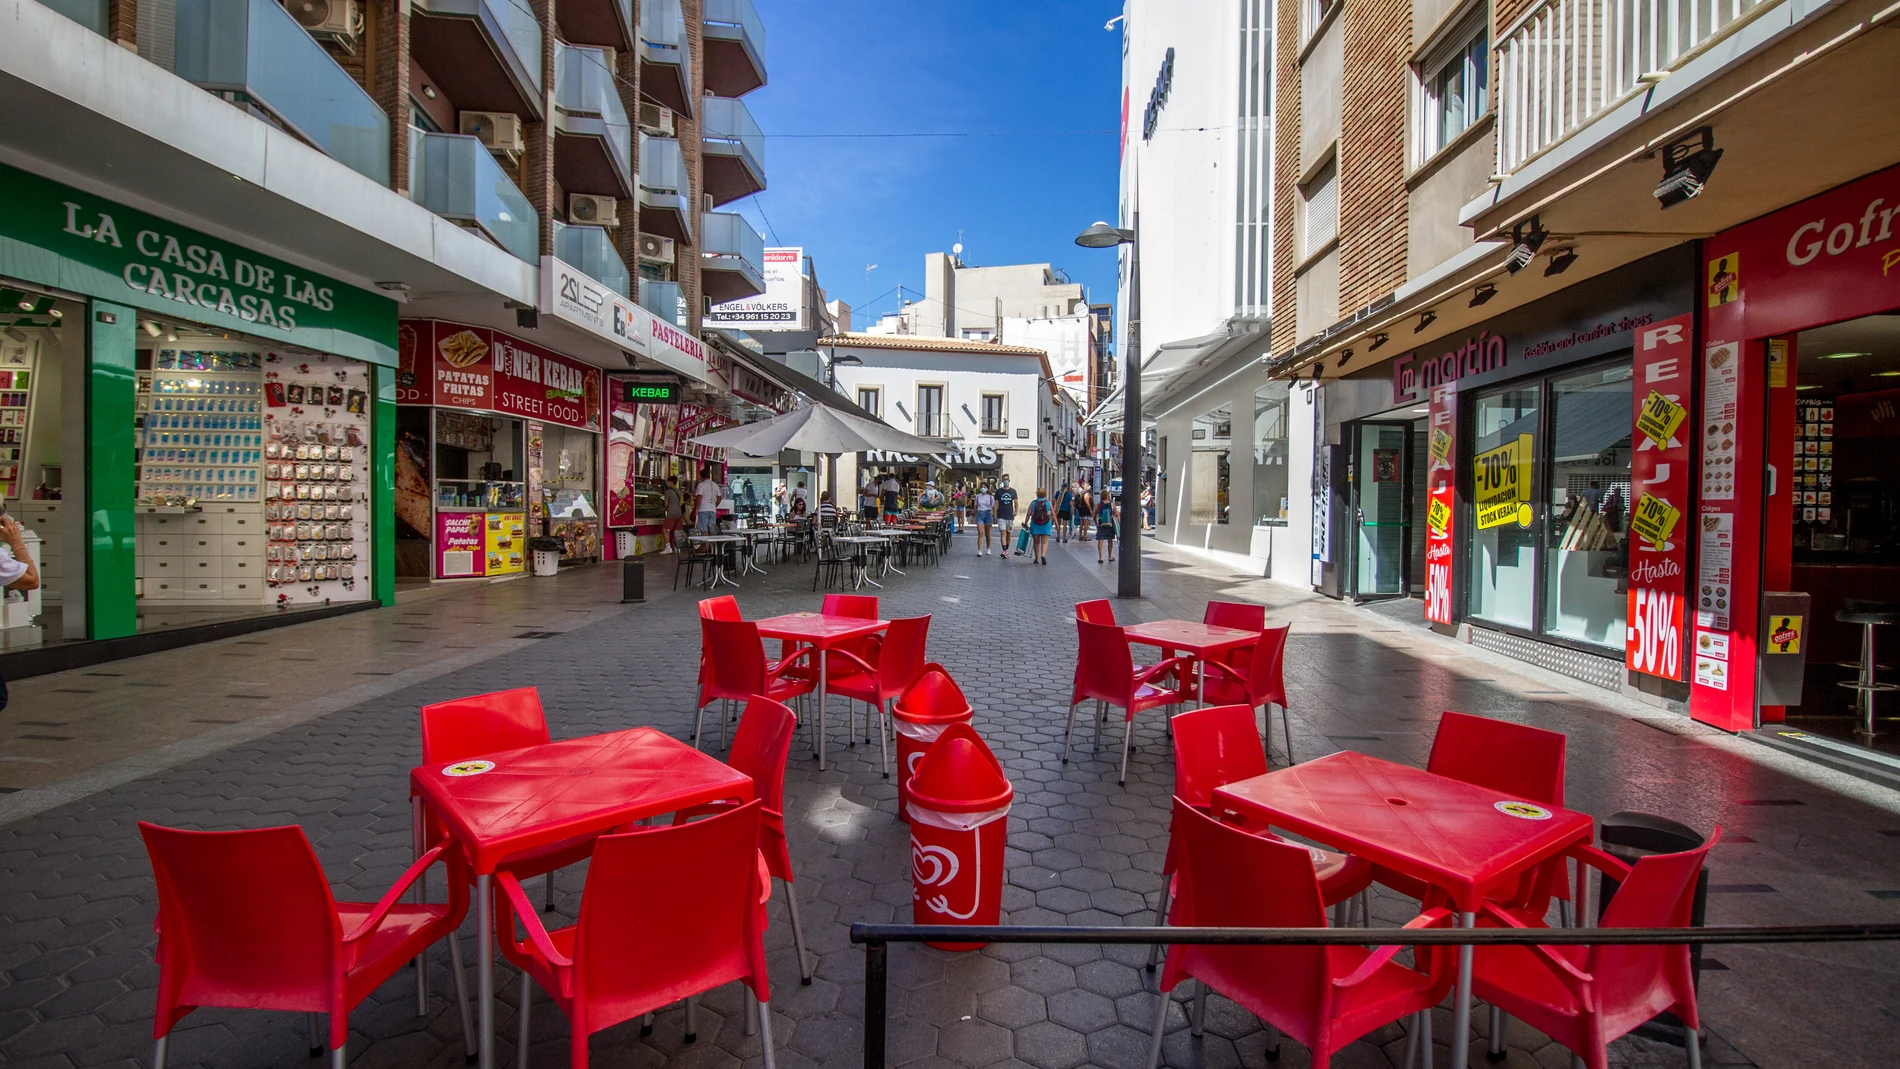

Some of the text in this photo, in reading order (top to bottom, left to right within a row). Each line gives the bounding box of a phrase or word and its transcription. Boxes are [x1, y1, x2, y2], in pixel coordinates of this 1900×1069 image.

[1786, 198, 1900, 266] Gofr
[63, 201, 334, 312] LA CASA DE LAS
[123, 263, 296, 331] CARCASAS
[560, 300, 604, 327] APARTMENTS
[651, 319, 704, 362] PASTELERIA
[1524, 313, 1653, 359] fashion and comfort shoes
[1421, 330, 1507, 389] martín
[437, 369, 490, 386] PATATAS
[443, 382, 485, 397] FRITAS
[632, 387, 670, 398] KEBAB
[451, 396, 476, 406] CHIPS
[502, 391, 544, 415] STREET
[547, 403, 579, 422] FOOD
[1648, 394, 1672, 426] -70%
[1636, 324, 1684, 552] REAJ
[1430, 387, 1453, 540] REAJS
[1476, 448, 1517, 491] -70%
[445, 519, 471, 527] SALCHI
[1480, 502, 1518, 526] STOCK VERANO
[1640, 495, 1667, 527] -70%
[445, 526, 470, 534] PAPAS
[448, 537, 479, 545] Patatas
[1633, 522, 1646, 534] STOCK
[1427, 542, 1450, 560] Hasta
[1631, 557, 1681, 583] Hasta
[1425, 562, 1450, 623] -50%
[1627, 587, 1678, 678] -50%
